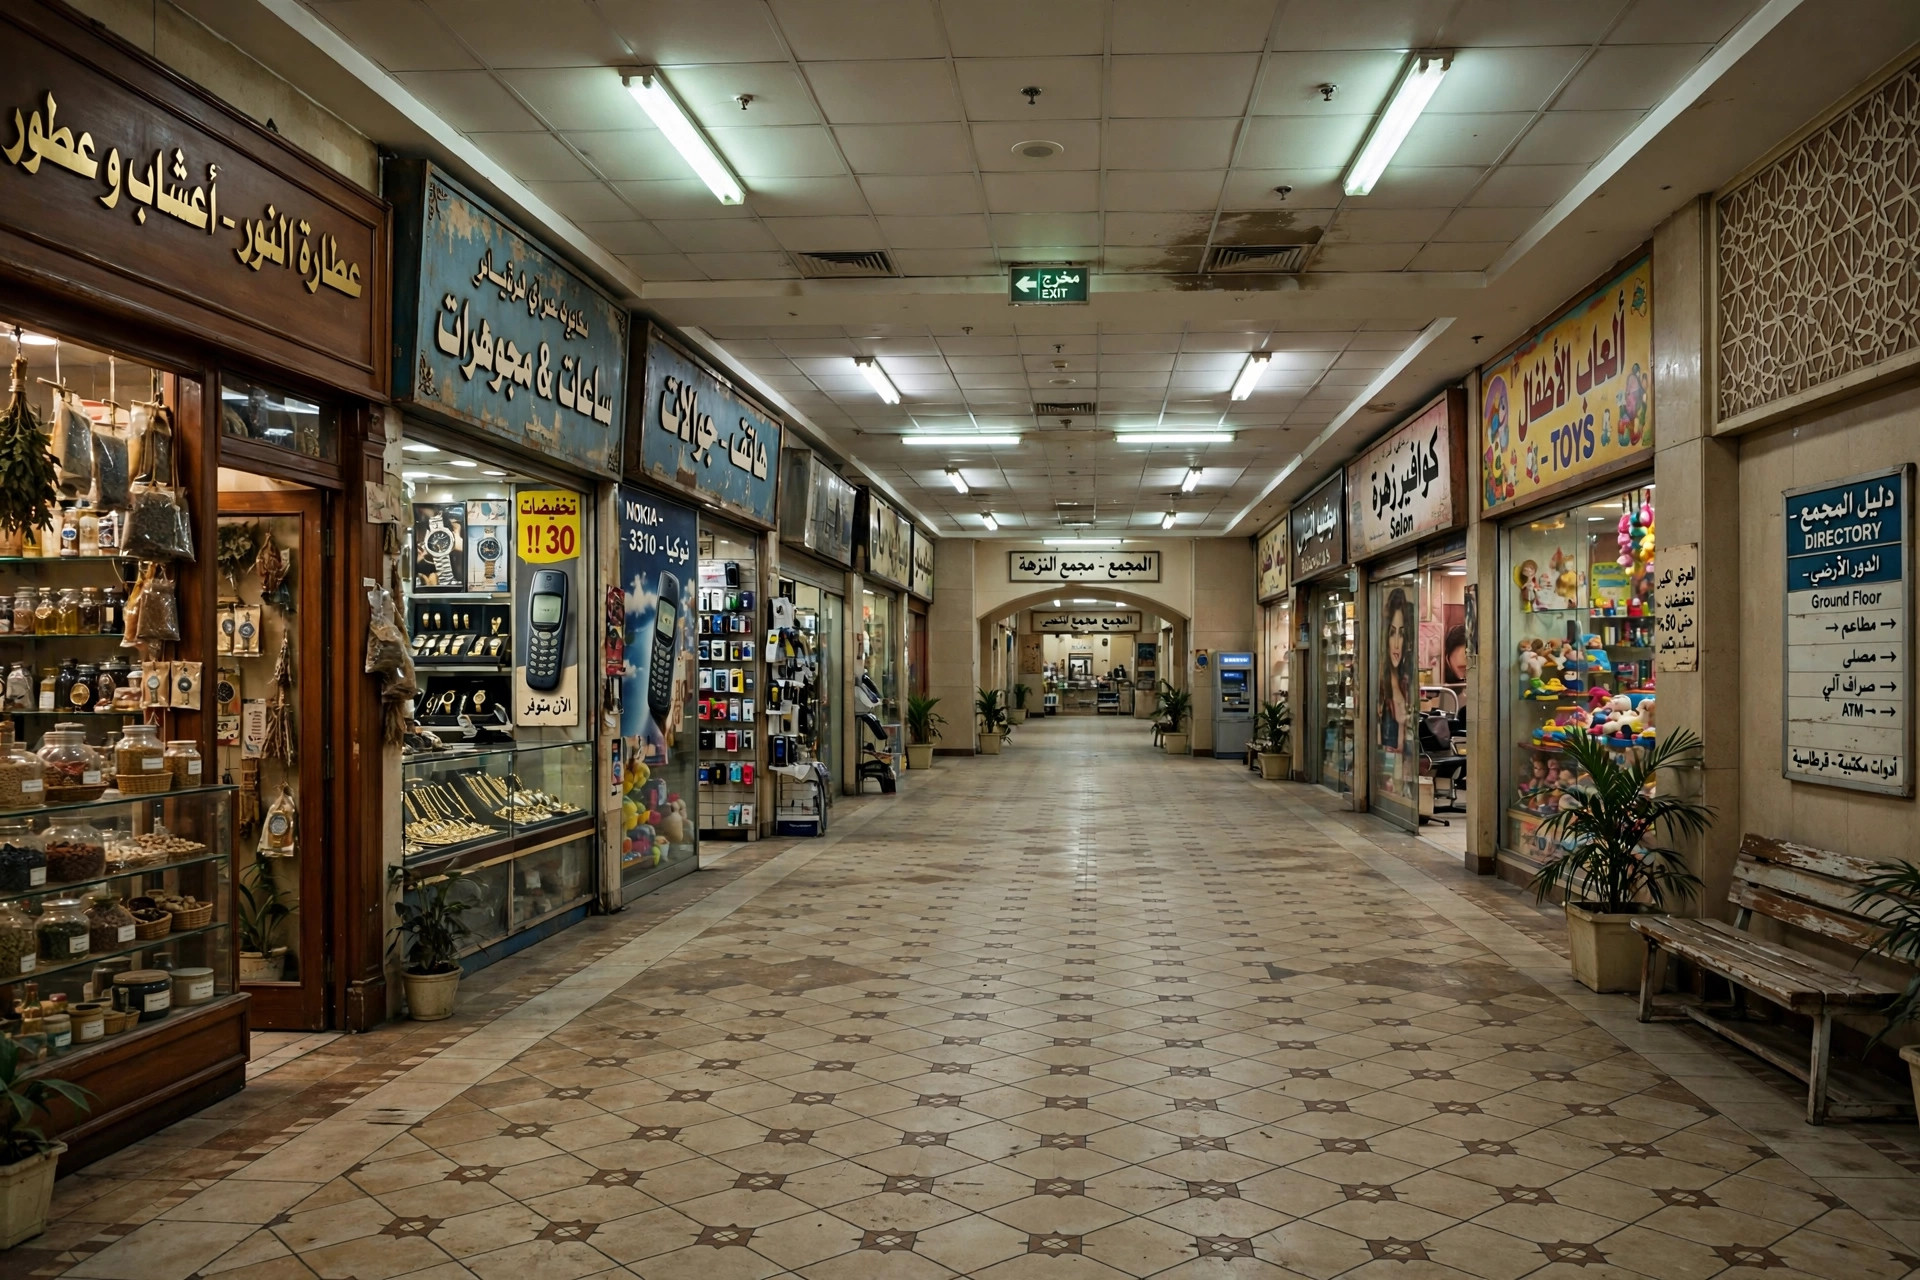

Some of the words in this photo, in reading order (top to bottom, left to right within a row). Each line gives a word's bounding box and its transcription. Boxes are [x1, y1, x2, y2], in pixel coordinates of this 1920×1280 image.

[1, 91, 99, 180] عطور
[100, 147, 121, 209] و
[128, 147, 217, 235] أعشاب
[236, 204, 294, 271] النور
[299, 219, 362, 299] عطارة
[1042, 271, 1080, 288] مخرج
[1042, 288, 1068, 298] EXIT
[437, 294, 533, 401] مجوهرات
[1576, 289, 1626, 413] ألعاب
[536, 341, 553, 400] &
[559, 354, 613, 427] ساعات
[1518, 338, 1572, 442] الأطفال
[661, 376, 718, 468] جوالات
[730, 418, 768, 481] هاتف
[1551, 413, 1595, 472] TOYS
[1397, 425, 1439, 509] كوافير
[1371, 463, 1396, 520] زهرة
[1857, 484, 1895, 518] دليل
[521, 497, 576, 520] تخفيضات
[626, 501, 657, 526] NOKIA
[1801, 491, 1853, 532] المجمع
[1390, 512, 1414, 539] Salon
[1805, 521, 1882, 550] DIRECTORY
[546, 525, 575, 555] 30
[629, 528, 657, 556] 3310
[666, 535, 690, 566] نوكيا
[1019, 556, 1057, 576] النزهة
[1060, 561, 1095, 578] مجمع
[1108, 556, 1152, 578] المجمع
[1810, 555, 1850, 586] الأرضي
[1851, 554, 1880, 578] الدور
[1811, 590, 1850, 609] Ground
[1852, 590, 1882, 606] Floor
[1841, 616, 1876, 639] مطاعم
[1843, 649, 1876, 668] مصلى
[1822, 674, 1841, 702] آلي
[1842, 676, 1876, 696] صراف
[524, 697, 551, 716] متوفر
[552, 696, 571, 715] الآن
[1842, 702, 1863, 718] ATM
[1792, 749, 1830, 771] قرطاسية
[1838, 753, 1869, 776] مكتبية
[1871, 756, 1898, 779] أدوات
